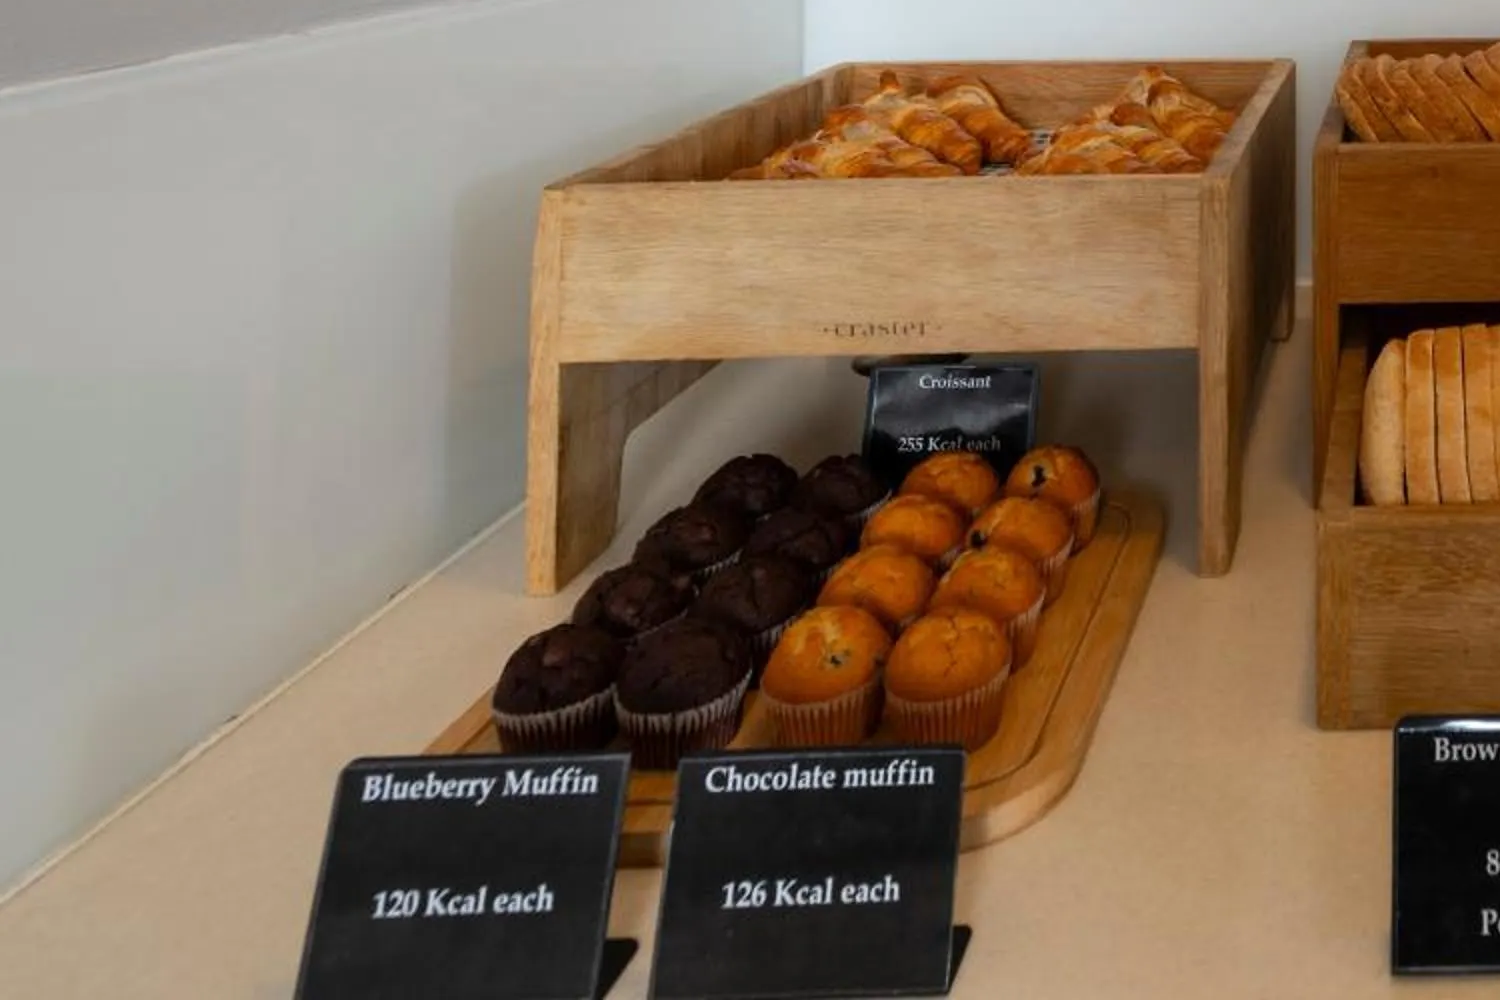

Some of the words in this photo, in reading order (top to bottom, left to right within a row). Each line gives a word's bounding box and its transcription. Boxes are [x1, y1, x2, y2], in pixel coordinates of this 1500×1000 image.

[918, 373, 992, 389] Croissant
[897, 436, 923, 452] 255
[927, 436, 962, 452] Kcal
[965, 434, 1001, 451] each
[361, 771, 497, 807] Blueberry
[501, 766, 599, 797] Muffin
[705, 763, 837, 793] Chocolate
[843, 759, 935, 789] muffin
[371, 889, 420, 919] 120
[424, 885, 488, 917] Kcal
[492, 882, 555, 914] each
[721, 880, 767, 909] 126
[773, 876, 835, 907] Kcal
[841, 874, 900, 904] each
